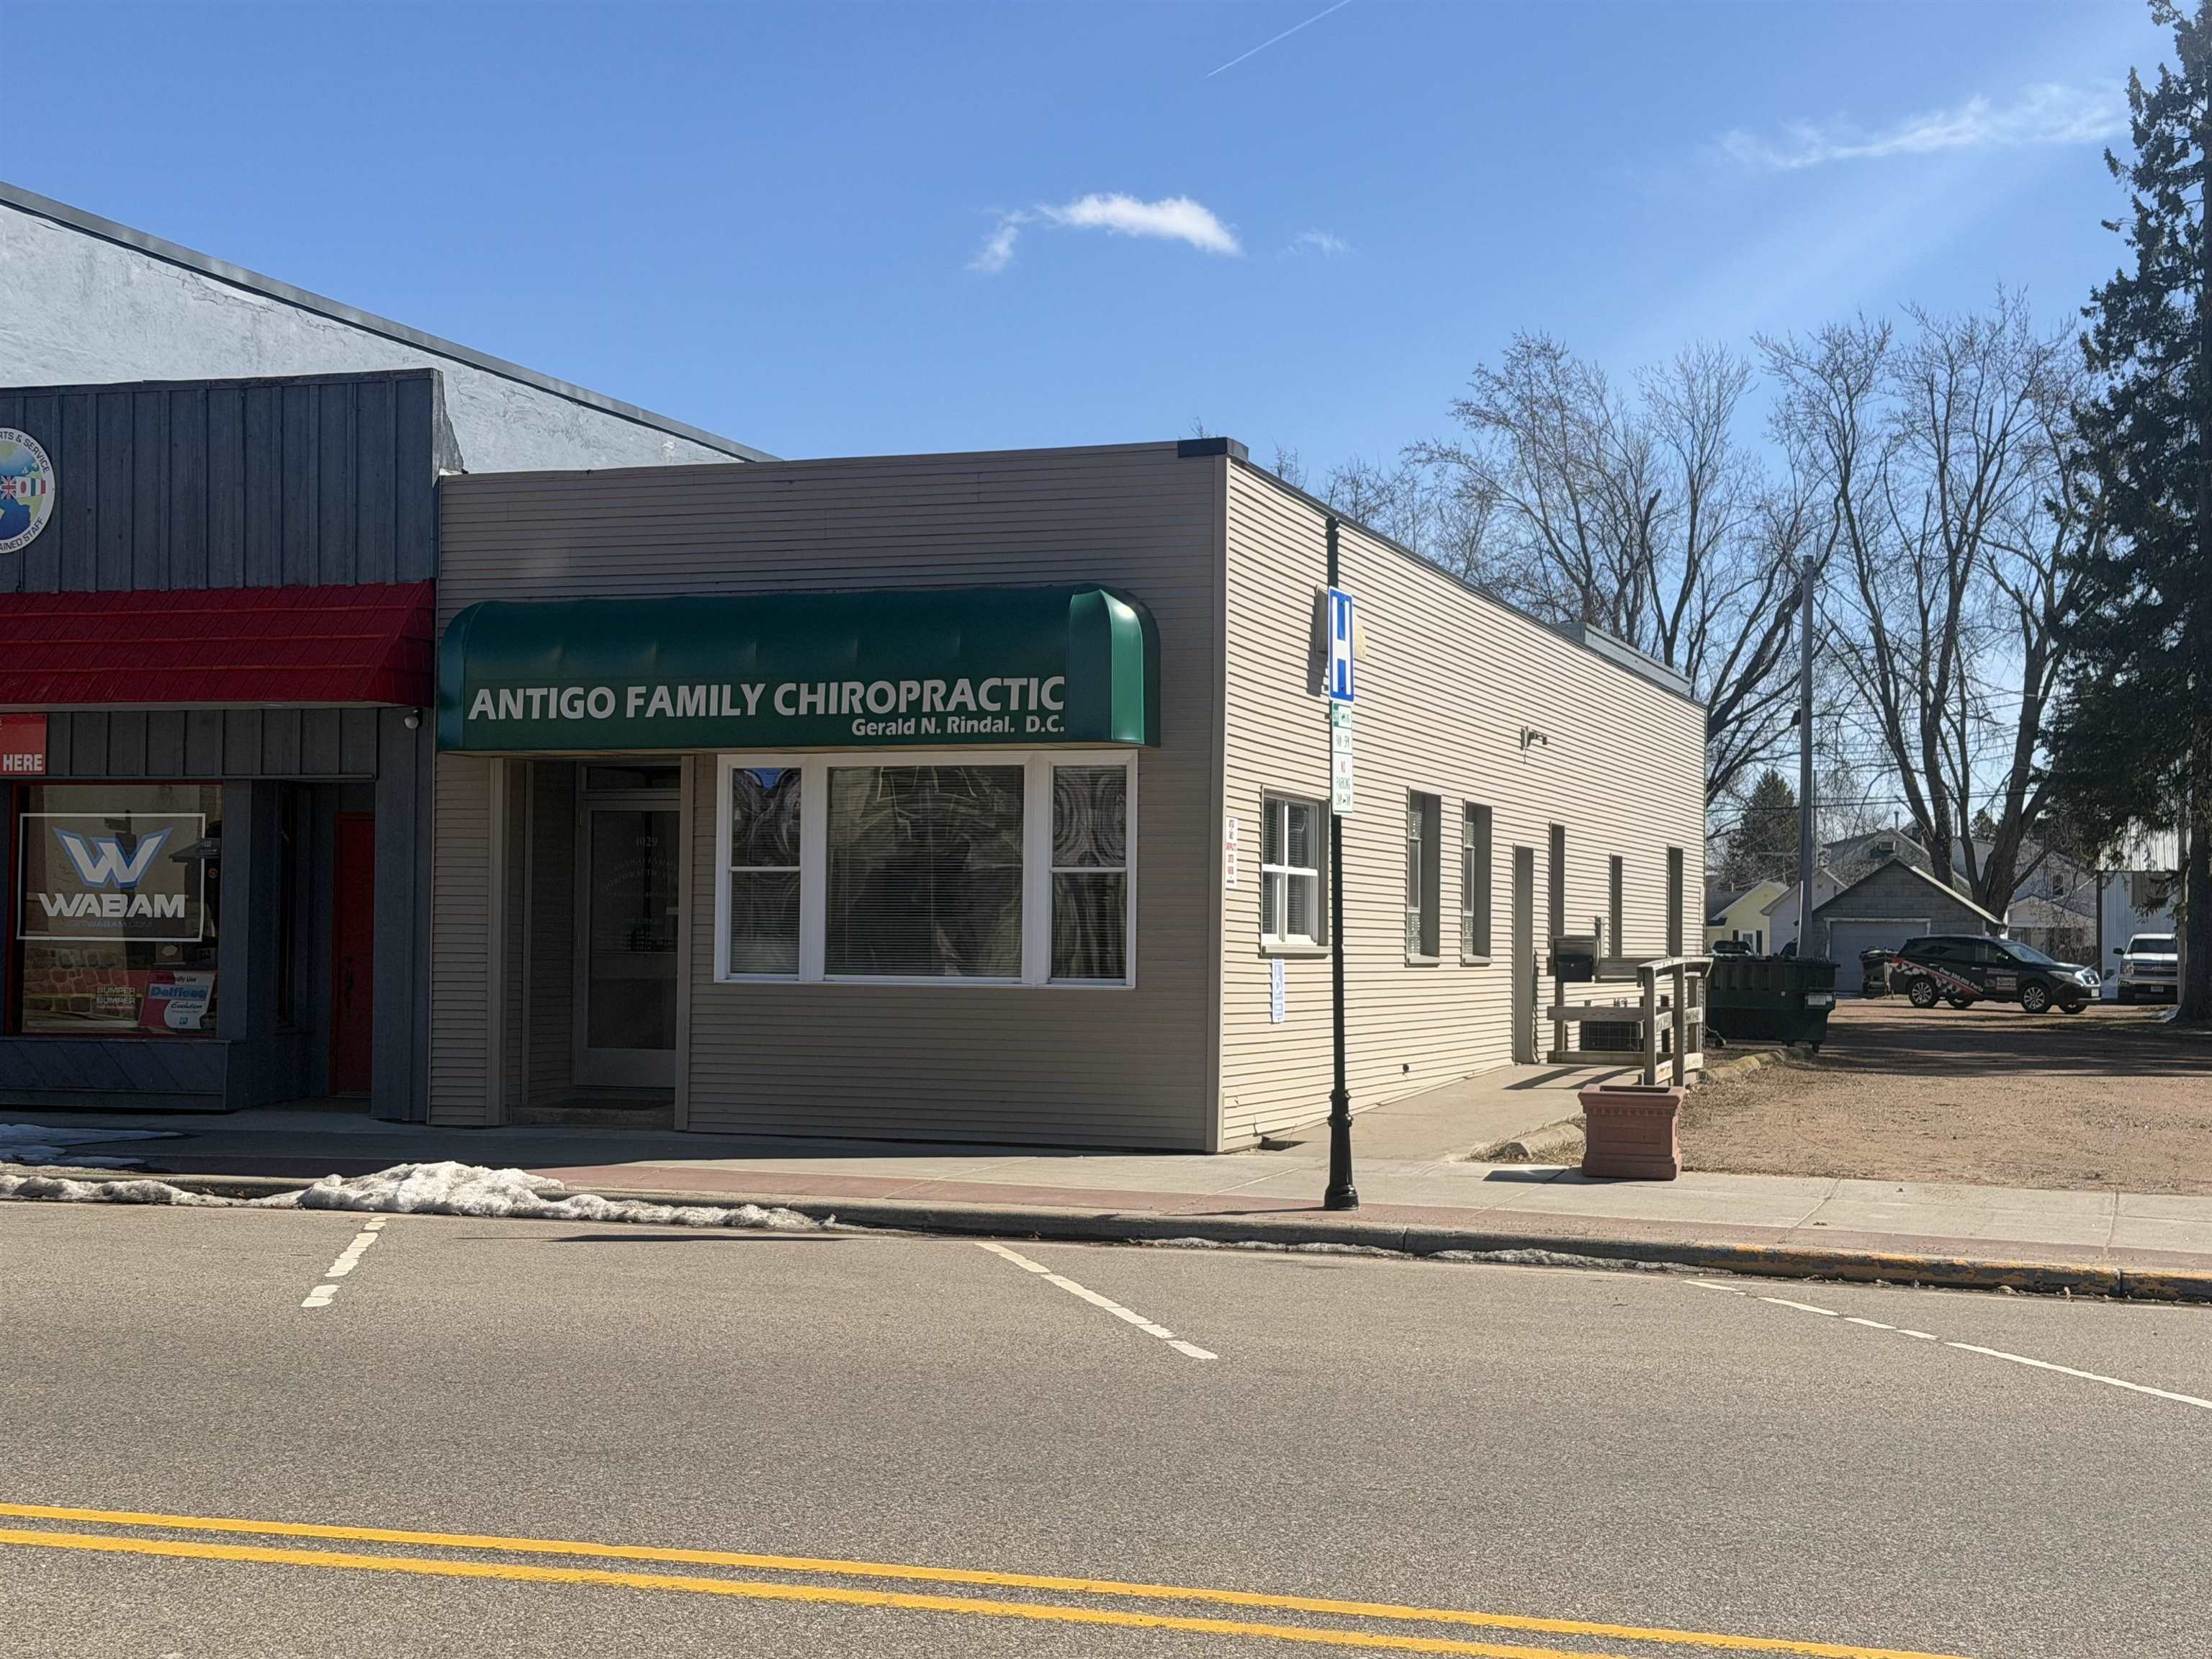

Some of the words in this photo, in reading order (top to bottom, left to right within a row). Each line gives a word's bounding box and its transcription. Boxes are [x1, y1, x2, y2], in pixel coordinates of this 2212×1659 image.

[16, 434, 22, 443] &
[24, 439, 50, 472] SERVICE
[23, 518, 43, 541] STAFF
[468, 686, 616, 719] ANTIGO
[626, 683, 765, 717] FAMILY
[774, 676, 1065, 716] CHIROPRACTIC
[852, 718, 915, 736] Gerald
[921, 719, 941, 734] N.
[1025, 715, 1065, 733] D.C.
[3, 754, 42, 771] HERE
[38, 894, 185, 917] WABAM
[1970, 982, 1983, 992] Parts
